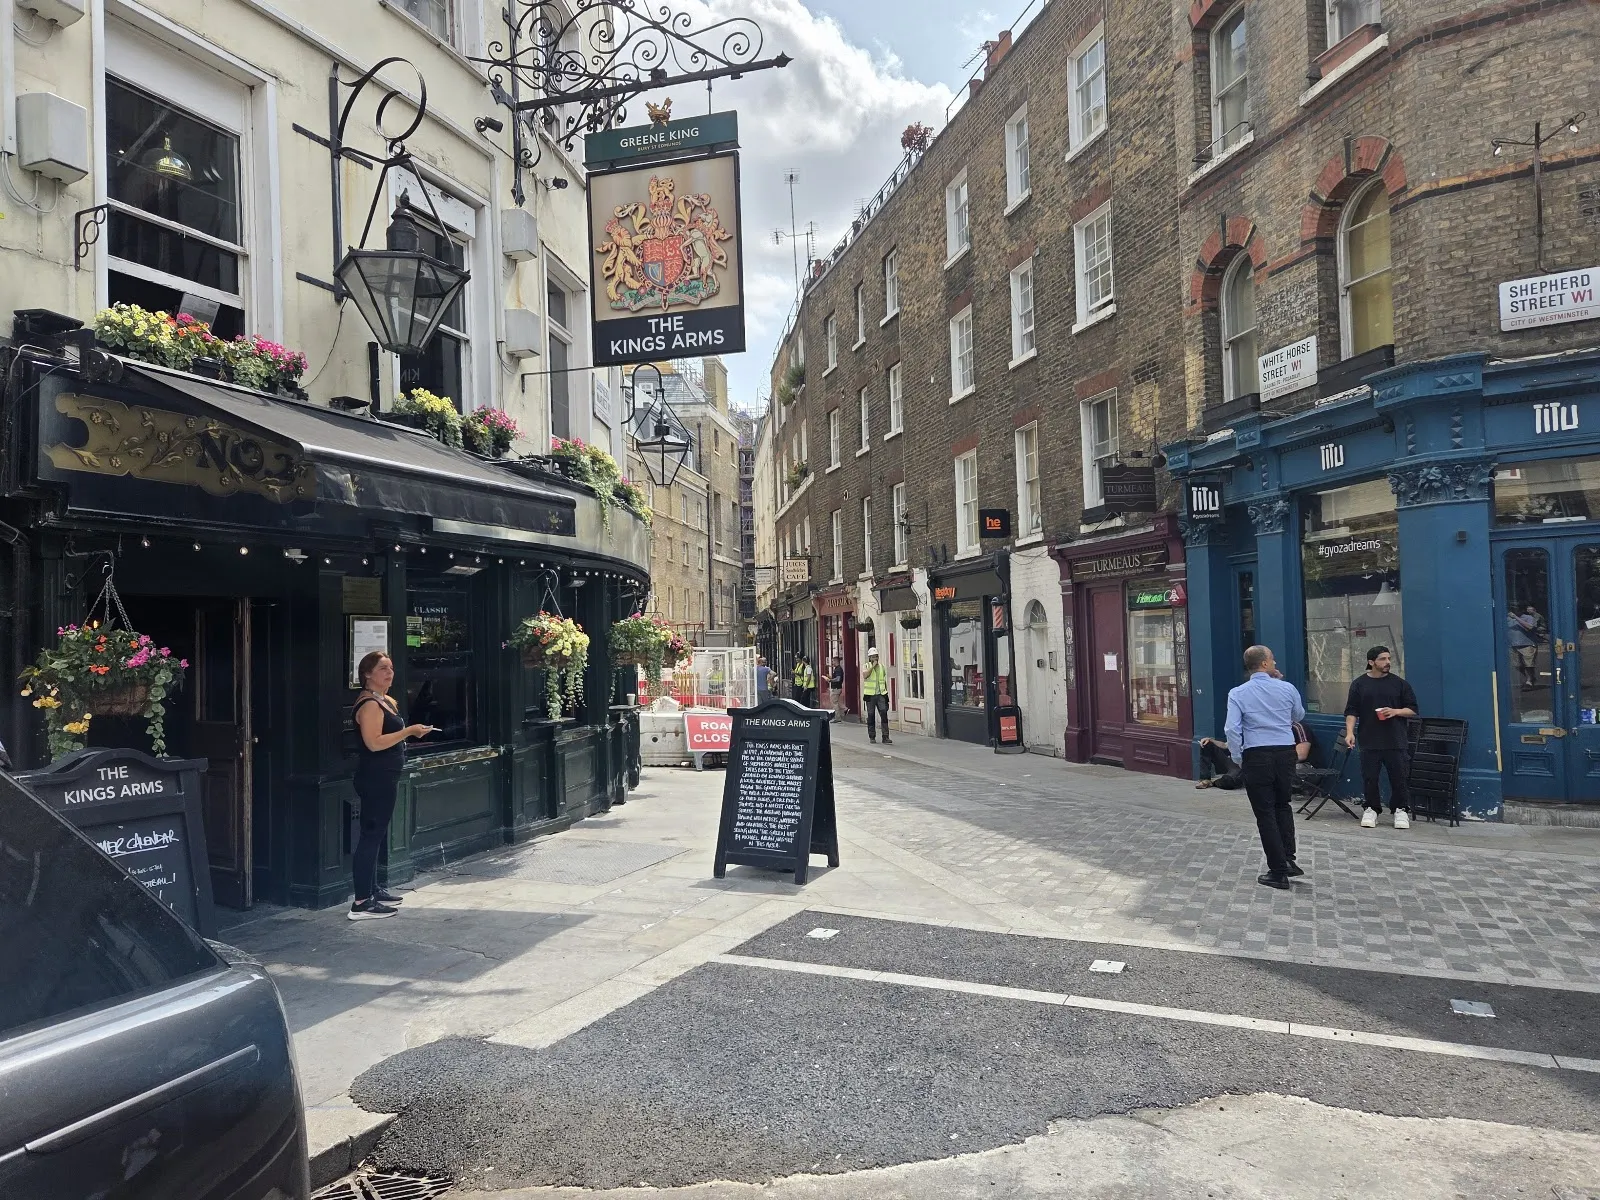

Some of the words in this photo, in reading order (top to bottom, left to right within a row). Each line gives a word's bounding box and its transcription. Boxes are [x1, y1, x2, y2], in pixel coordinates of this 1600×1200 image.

[620, 132, 666, 148] GREENE
[669, 127, 700, 140] KING
[1509, 273, 1590, 298] SHEPHERD
[1510, 292, 1566, 313] STREET
[1570, 288, 1592, 304] W1
[648, 315, 684, 334] THE
[1510, 319, 1526, 327] CITY
[1538, 309, 1589, 323] WESTMINSTER
[610, 334, 666, 356] KINGS
[672, 328, 725, 349] ARMS
[1262, 352, 1284, 370] WHITE
[1286, 341, 1310, 360] HORSE
[1262, 364, 1288, 383] STREET
[1291, 359, 1302, 372] W1
[1104, 484, 1154, 494] TURMEAUS
[986, 516, 1001, 528] he
[1318, 538, 1381, 558] #gyozadreams
[1092, 554, 1141, 573] TURMEAUS
[414, 606, 448, 614] CLASSIC
[762, 719, 786, 727] KINGS
[788, 720, 810, 728] ARMS
[96, 766, 129, 780] THE
[64, 786, 116, 804] KINGS
[120, 780, 164, 798] ARMS
[126, 830, 179, 850] CALENDAR
